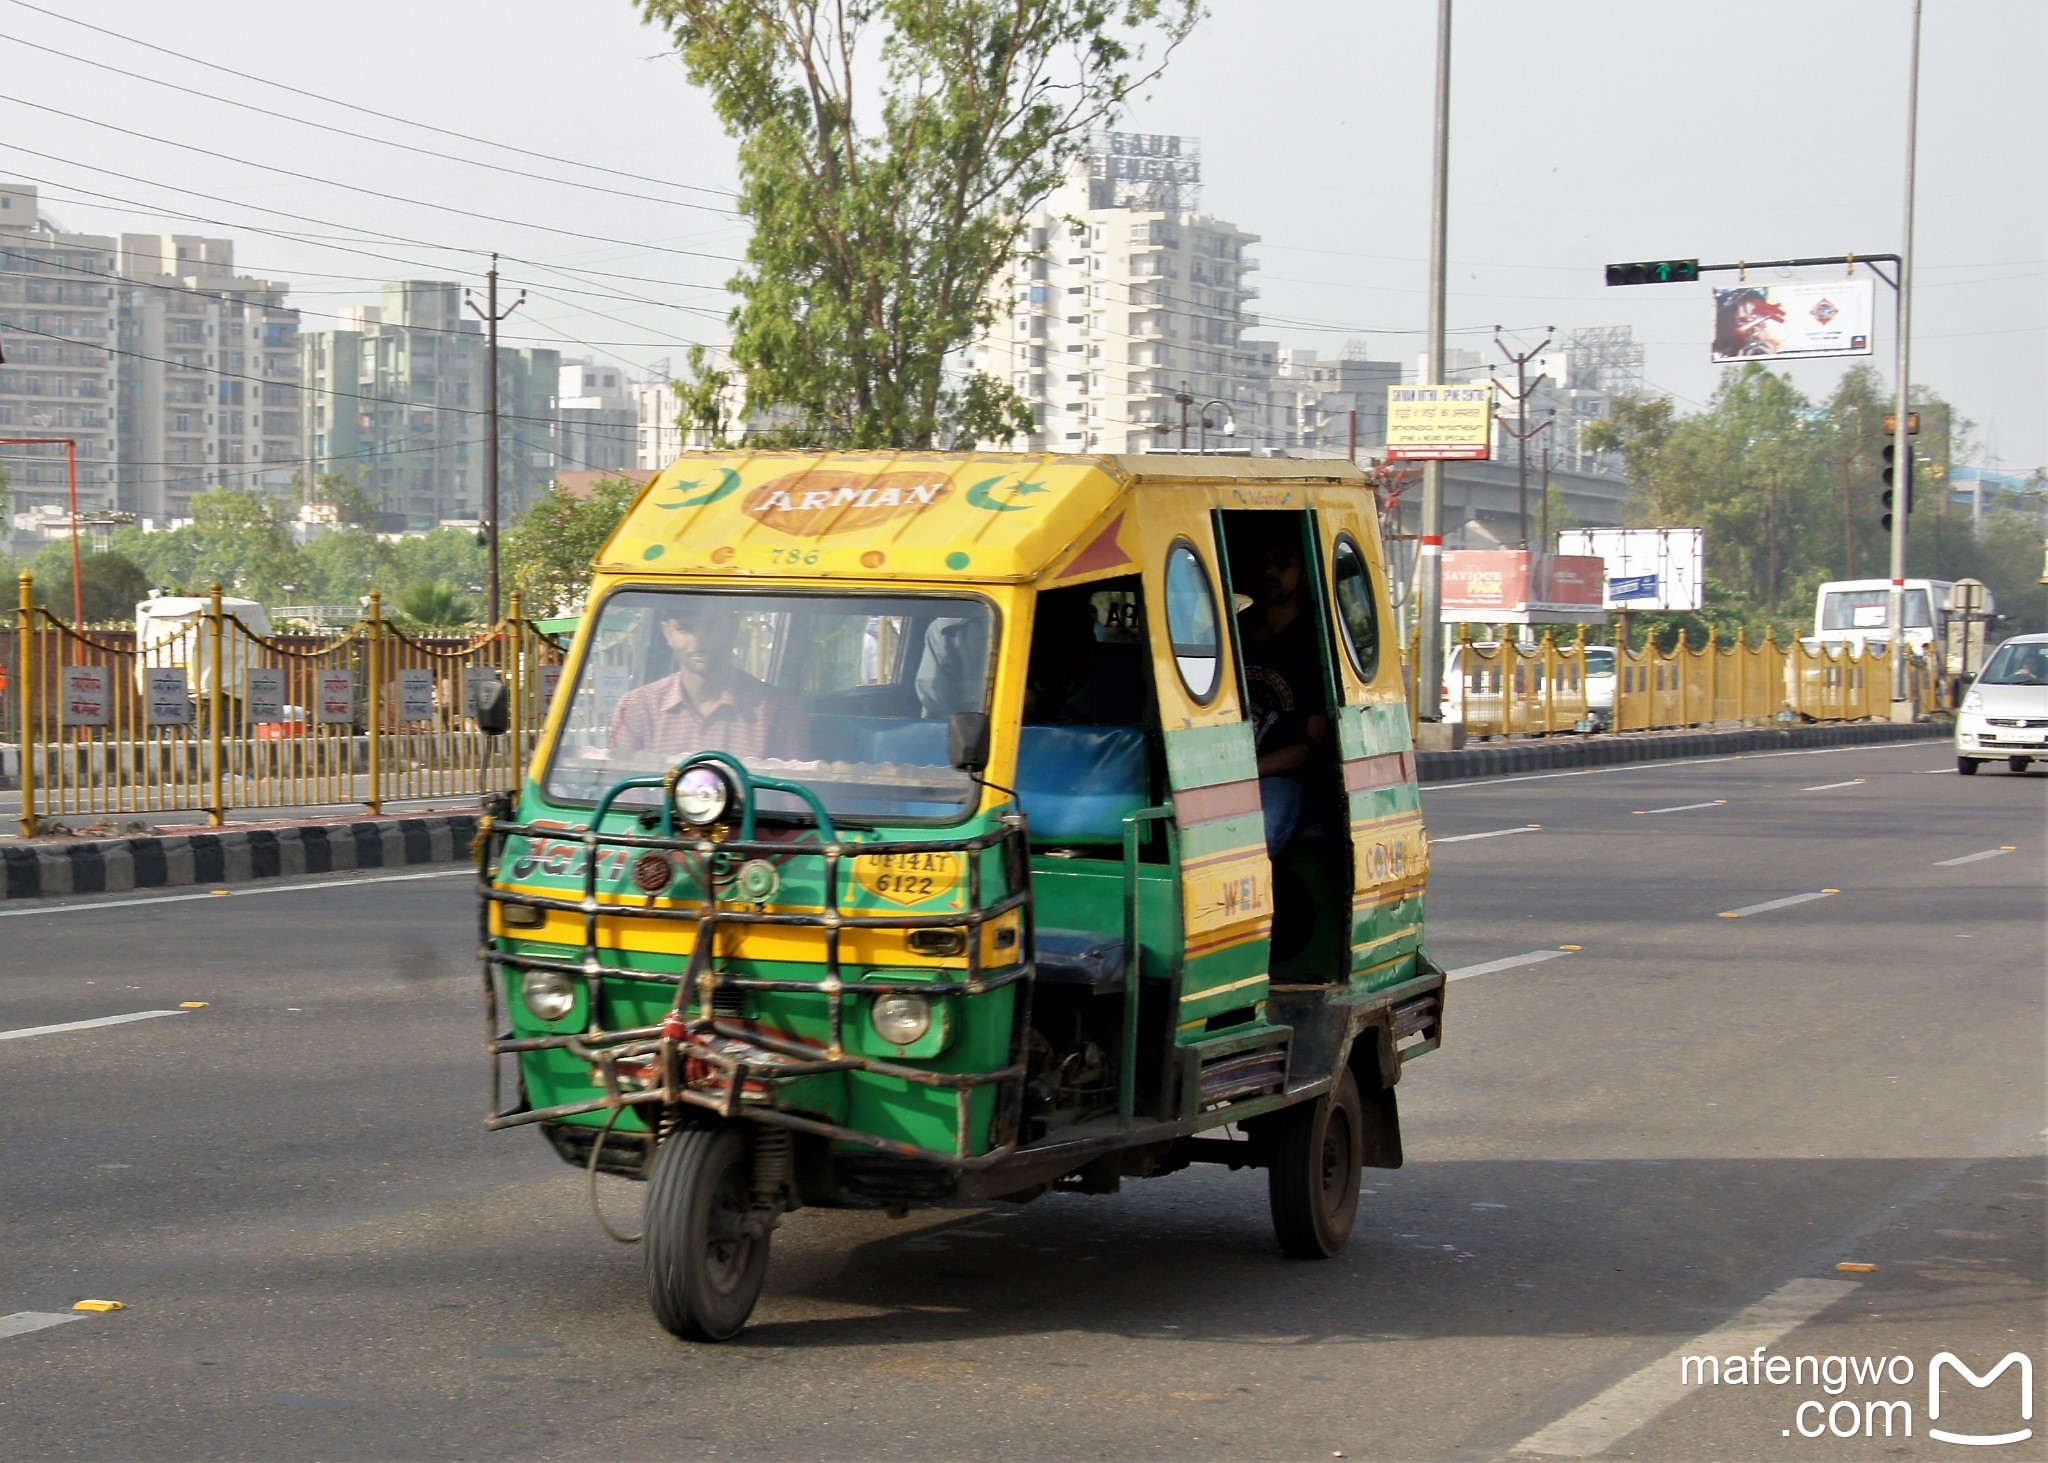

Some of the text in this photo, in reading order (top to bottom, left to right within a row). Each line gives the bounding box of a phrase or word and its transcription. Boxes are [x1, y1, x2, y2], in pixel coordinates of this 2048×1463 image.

[754, 482, 942, 511] ARMAN
[770, 548, 820, 566] 786
[1442, 571, 1504, 581] SAVIOUR
[876, 873, 934, 895] 6122
